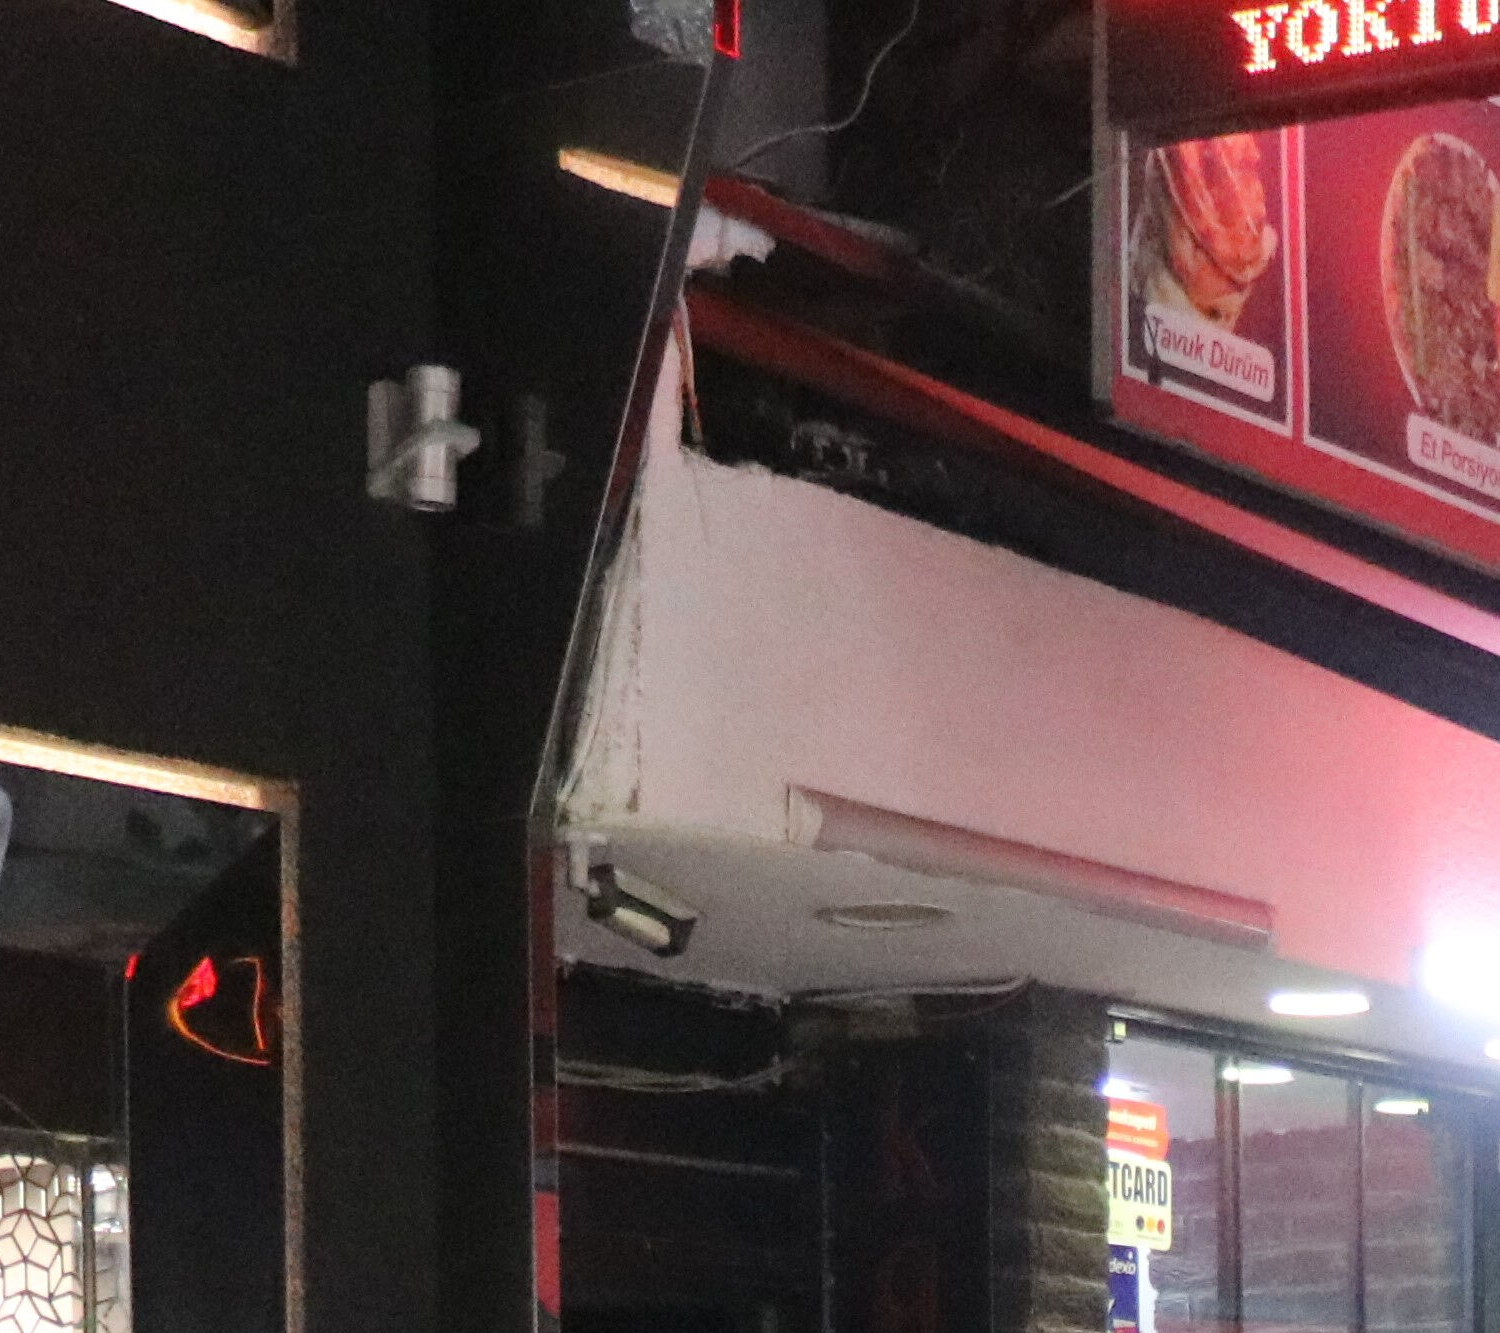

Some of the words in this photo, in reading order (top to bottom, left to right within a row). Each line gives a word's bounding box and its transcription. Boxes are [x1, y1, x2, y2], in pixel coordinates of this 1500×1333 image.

[1152, 315, 1205, 363] Tavuk
[1208, 340, 1270, 388] Dürüm
[1420, 431, 1437, 459] Et
[1108, 1162, 1169, 1206] TCARD
